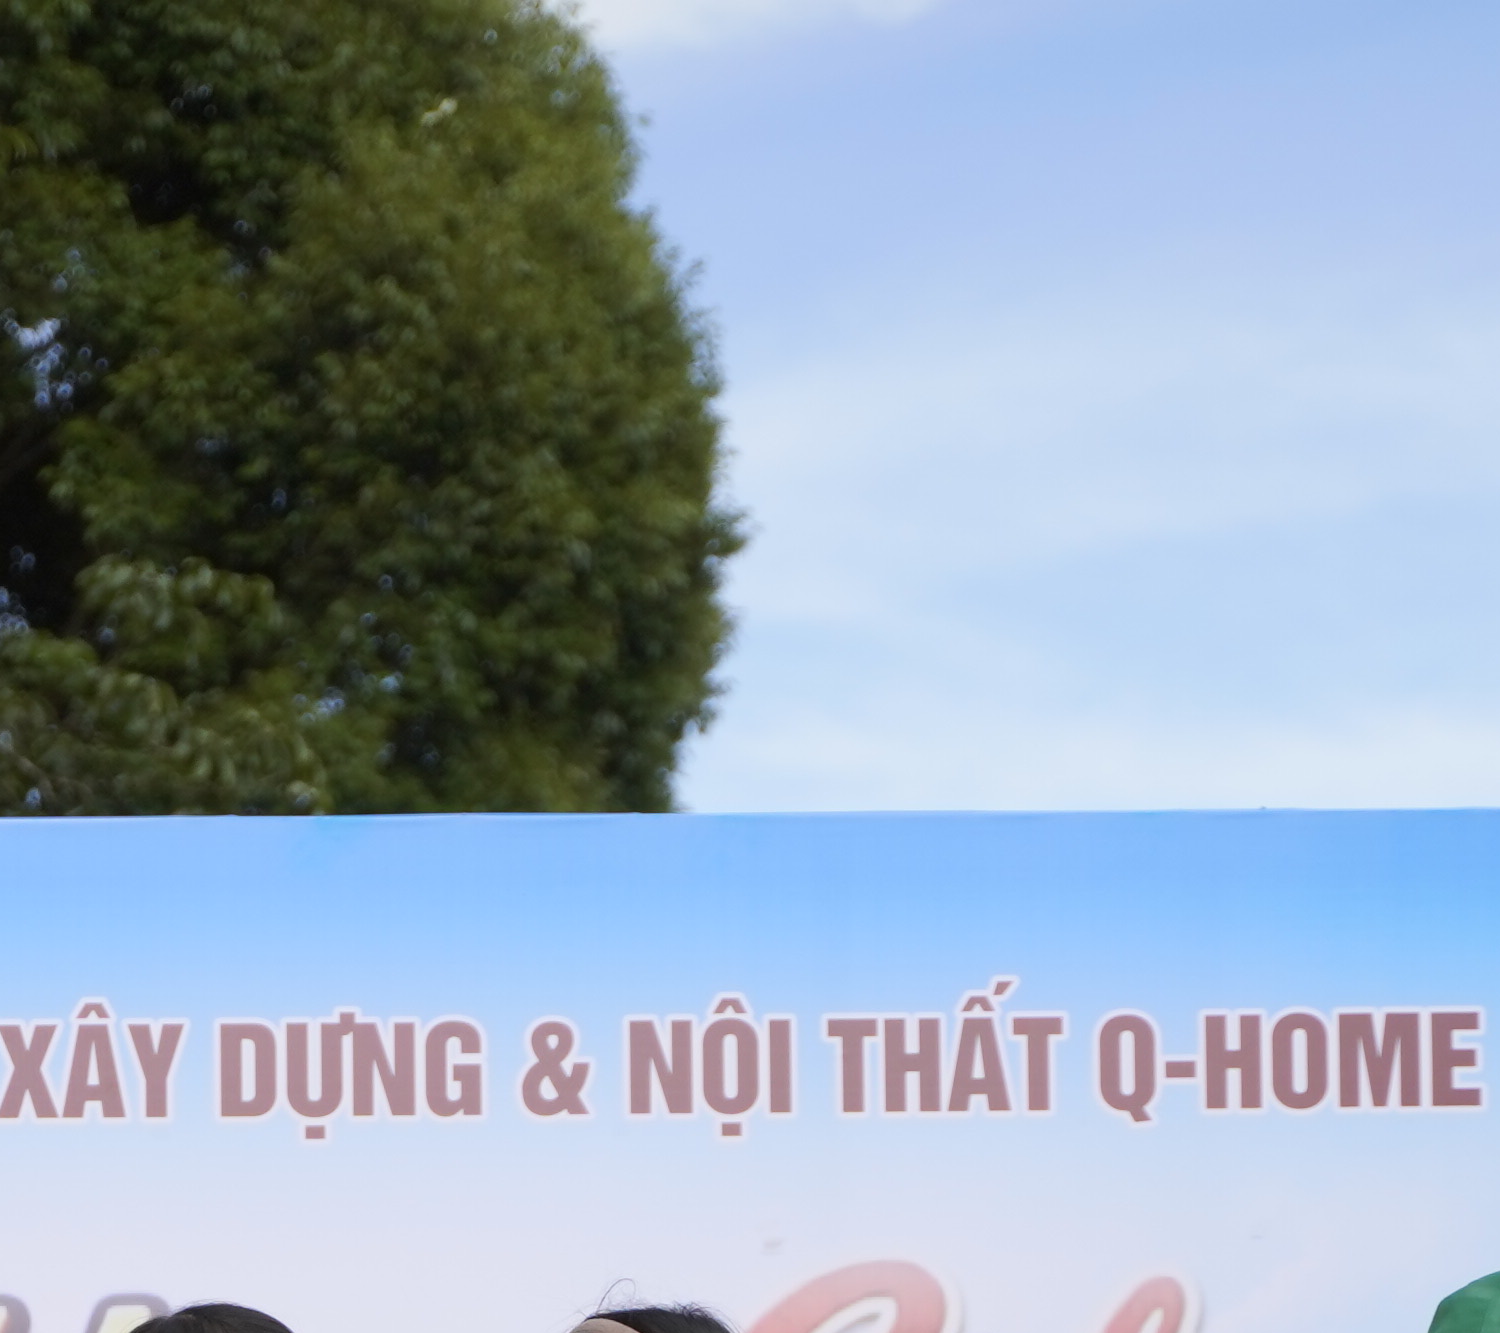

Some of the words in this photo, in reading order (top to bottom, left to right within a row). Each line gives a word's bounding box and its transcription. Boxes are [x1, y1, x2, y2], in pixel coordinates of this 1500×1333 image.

[221, 1013, 481, 1139] DỰNG
[522, 1022, 588, 1116] &
[630, 999, 791, 1136] NỘI
[828, 982, 1062, 1112] THẤT
[1100, 1012, 1481, 1122] Q-HOME
